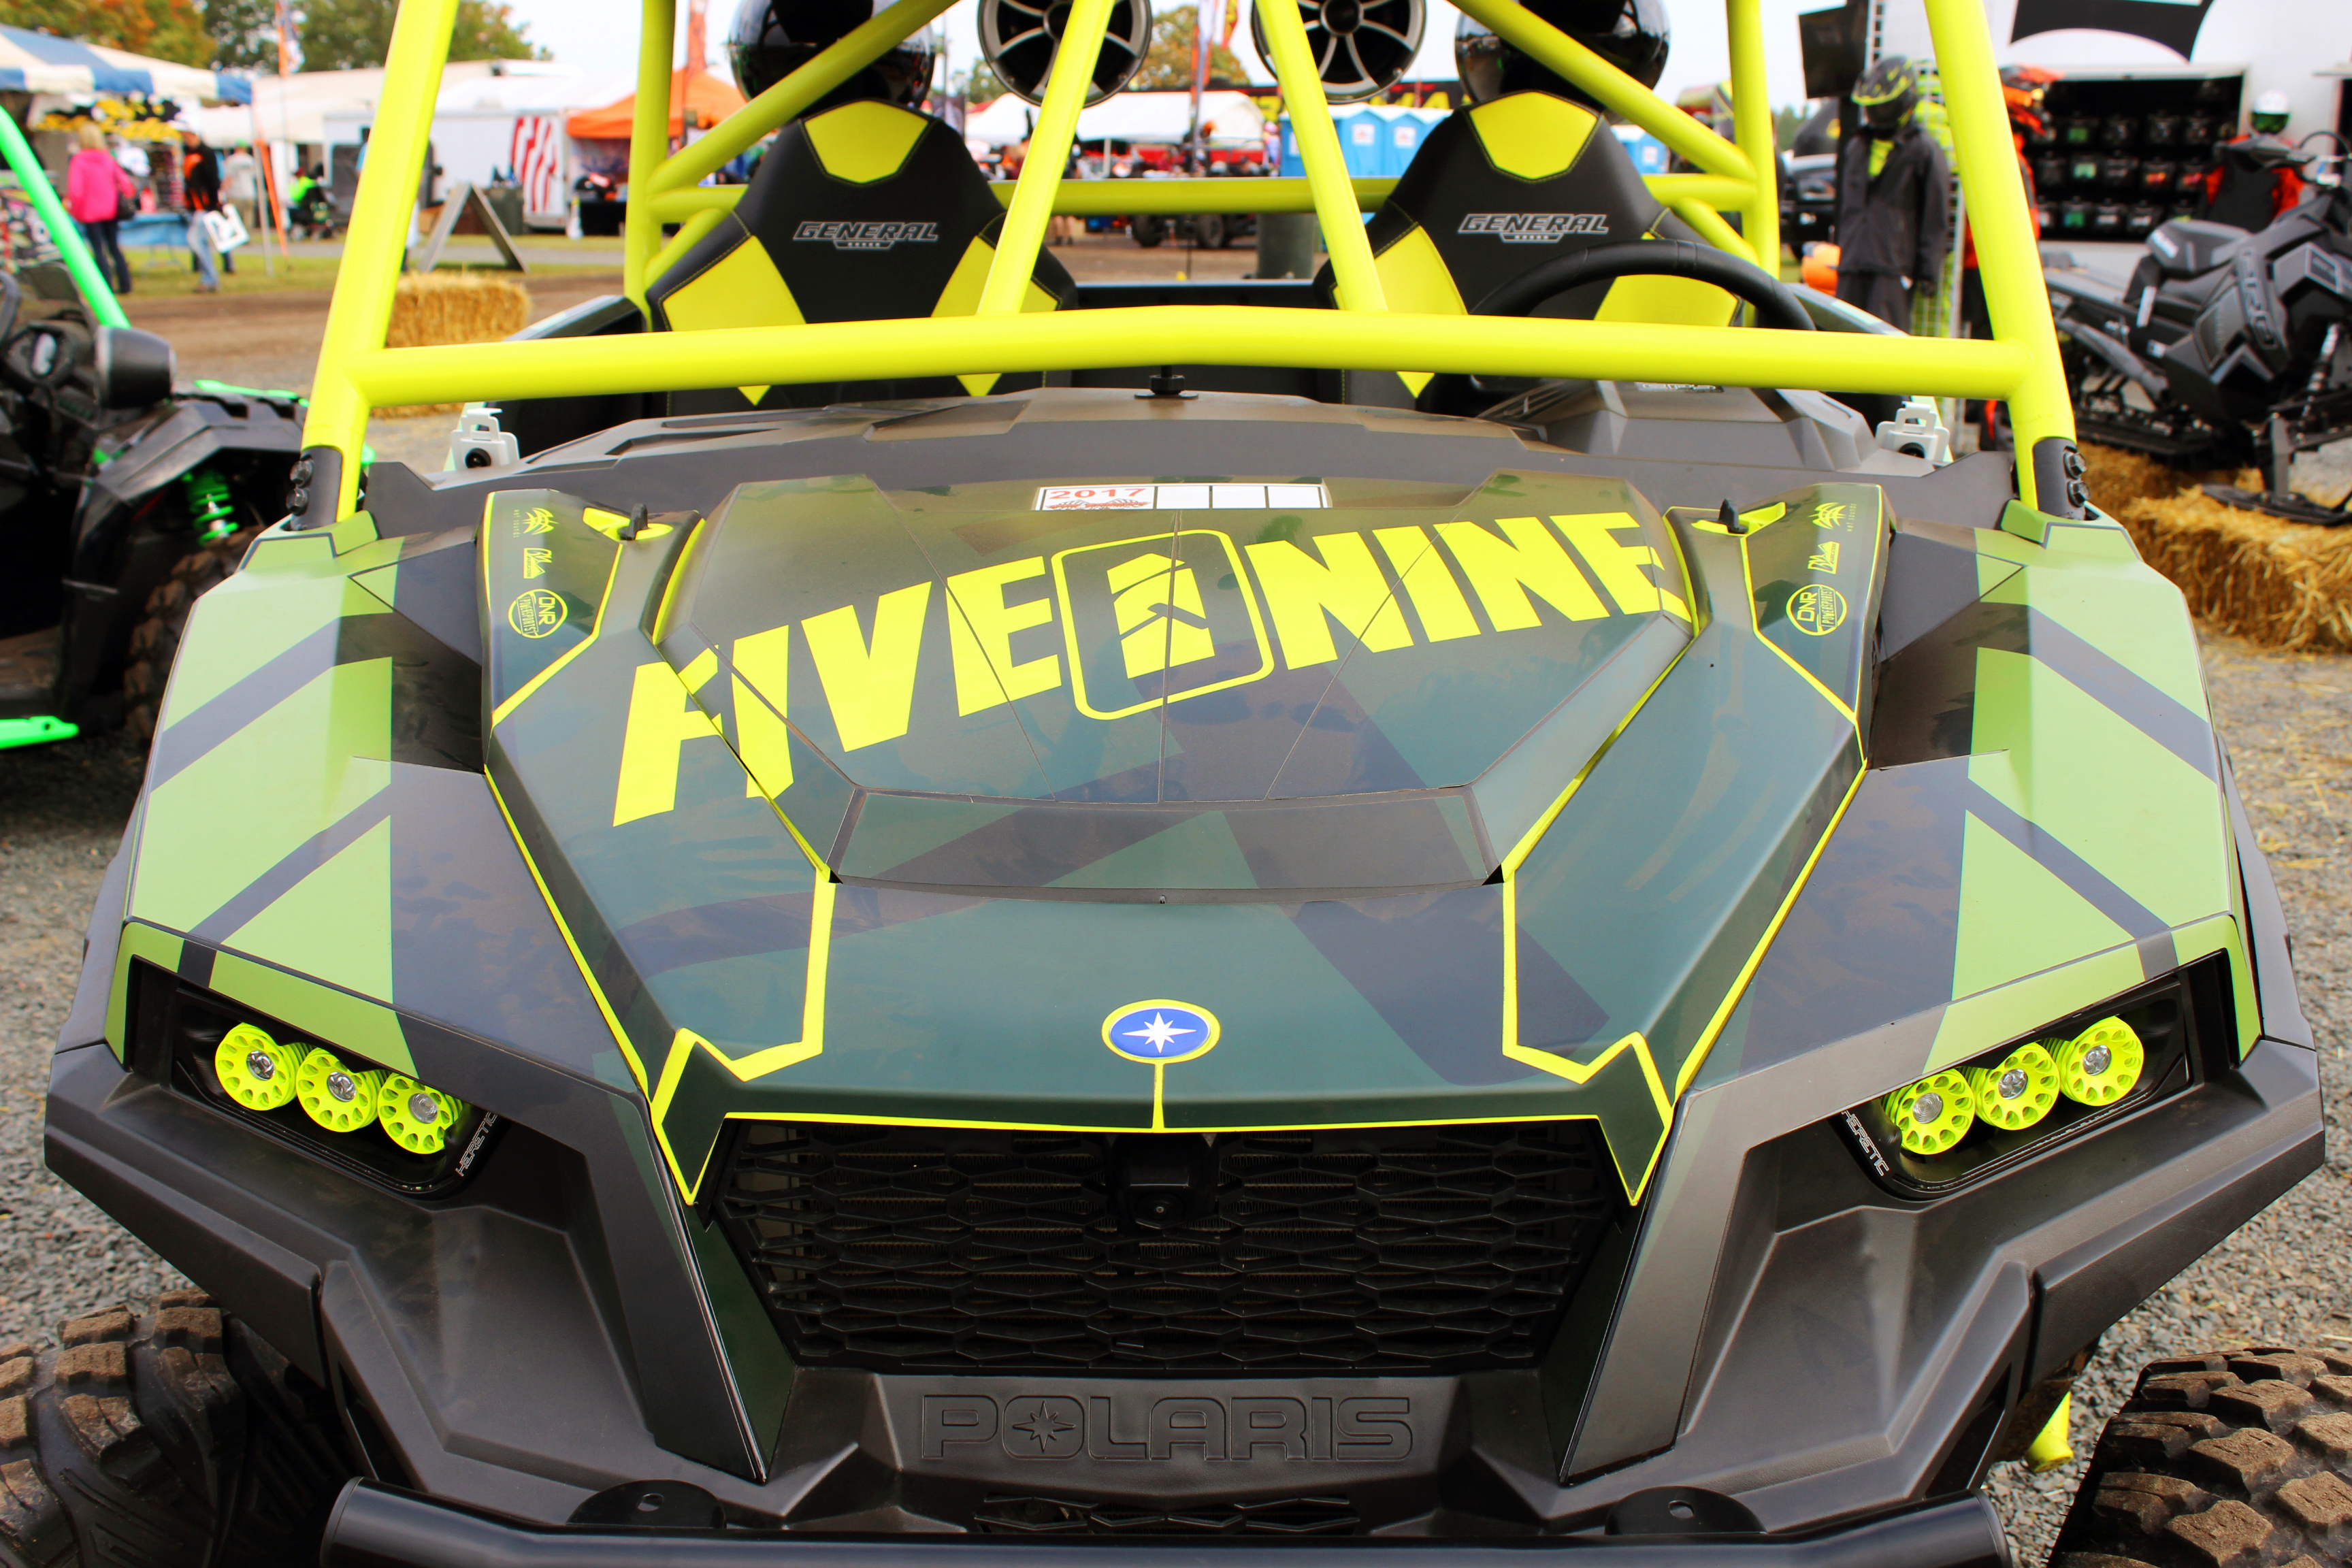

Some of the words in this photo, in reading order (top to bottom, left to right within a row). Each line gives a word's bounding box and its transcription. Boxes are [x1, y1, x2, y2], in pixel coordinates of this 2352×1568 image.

[793, 221, 938, 242] GENERAL
[1457, 213, 1610, 235] GENERAL
[1049, 487, 1146, 500] 2017
[519, 598, 536, 632] POWERSPORTS
[538, 596, 556, 625] DNR
[1797, 591, 1818, 622] DNR
[1820, 589, 1835, 625] POWERSPORTS
[612, 555, 1063, 827] FIVE
[1245, 511, 1692, 670] NINE
[455, 1111, 497, 1177] HERETIC
[1841, 1110, 1890, 1176] HERETIC
[921, 1394, 1414, 1461] POLARIS
